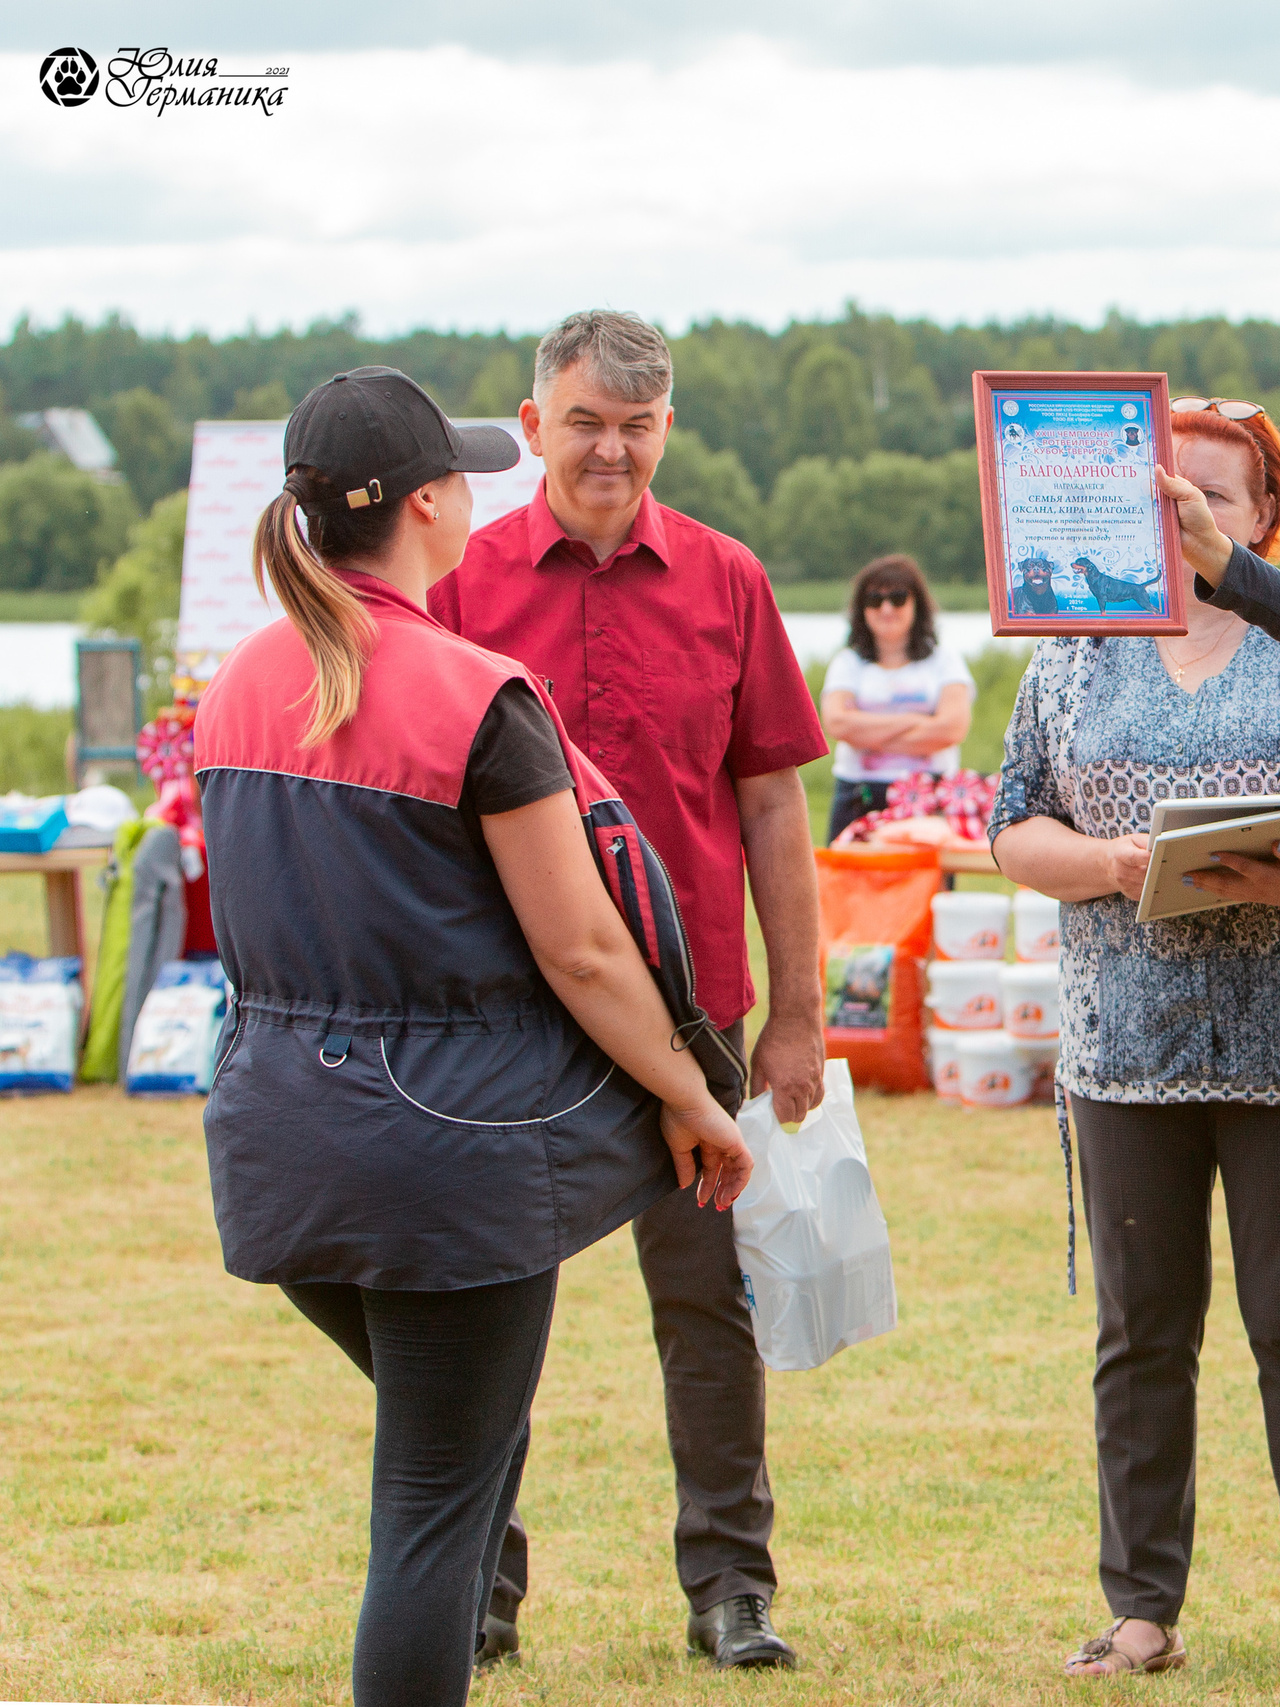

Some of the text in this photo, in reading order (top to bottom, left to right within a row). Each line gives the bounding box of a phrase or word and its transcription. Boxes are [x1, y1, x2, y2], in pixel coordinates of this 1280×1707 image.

[1058, 430, 1114, 438] ЧЕМПИОНАТ
[1019, 464, 1137, 480] БЛАГОДАРНОСТЬ
[1053, 483, 1105, 491] НАГРАЖДАЕТСЯ
[1028, 495, 1063, 503] СЕМЬЯ
[1064, 495, 1124, 503] АМИРОВЫХ
[1012, 506, 1056, 514] ОКСАНА,
[1058, 506, 1085, 514] КИРА
[1094, 506, 1144, 515] МАГОМЕД
